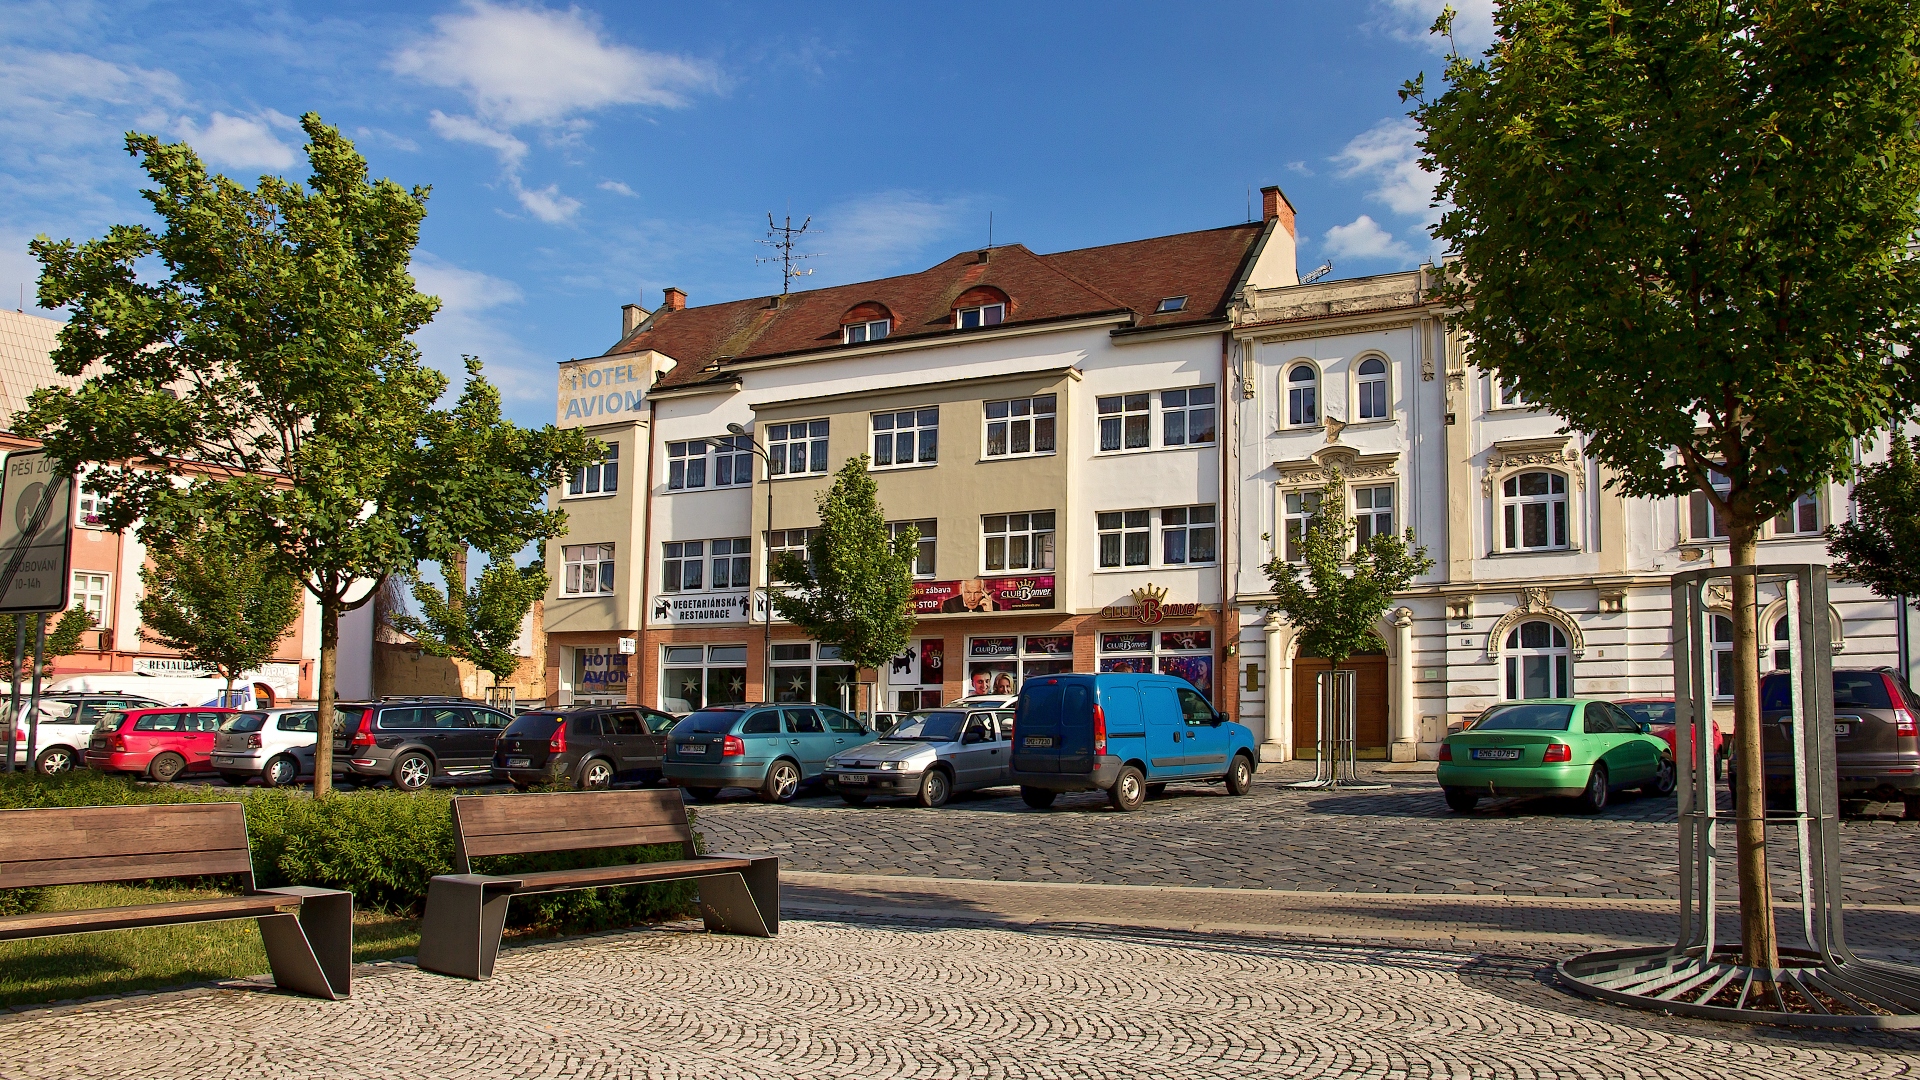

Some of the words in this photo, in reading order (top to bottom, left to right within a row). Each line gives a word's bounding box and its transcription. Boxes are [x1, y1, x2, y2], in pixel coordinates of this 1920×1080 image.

[564, 389, 642, 420] AVION
[11, 458, 35, 477] PĚŠÍ
[15, 577, 41, 590] 10-14h
[925, 586, 951, 594] zábava
[1001, 590, 1021, 598] CLUB
[673, 596, 737, 609] VEGETARIÁNSKÁ
[904, 601, 938, 609] ON-STOP
[680, 609, 730, 620] RESTAURACE
[1101, 605, 1141, 618] CLUB
[1137, 598, 1202, 625] Bonver
[582, 654, 628, 666] HOTEL
[583, 671, 628, 683] AVION
